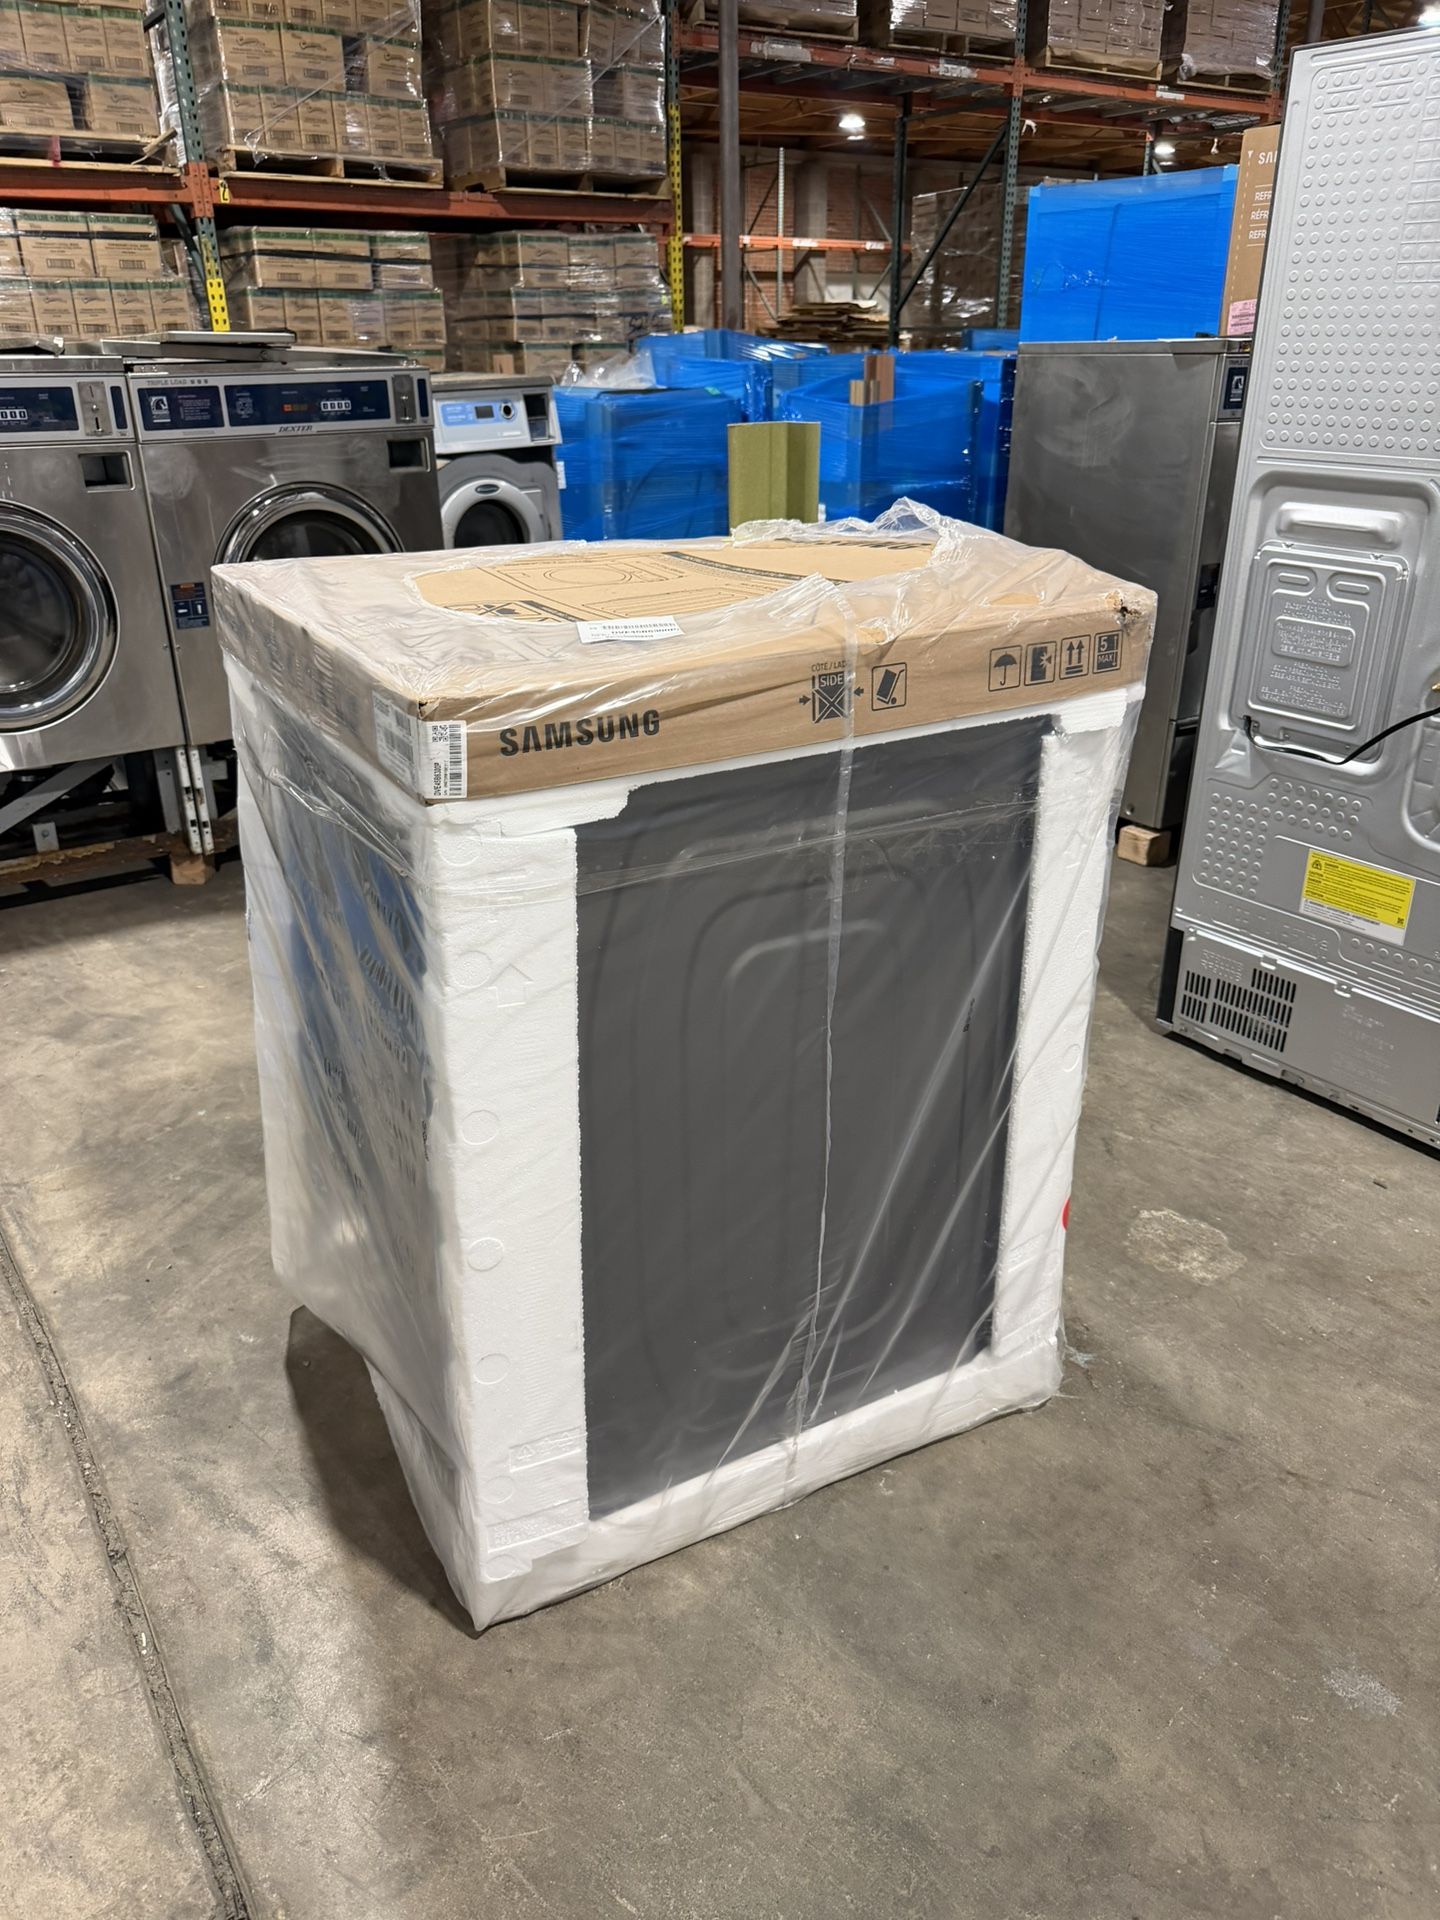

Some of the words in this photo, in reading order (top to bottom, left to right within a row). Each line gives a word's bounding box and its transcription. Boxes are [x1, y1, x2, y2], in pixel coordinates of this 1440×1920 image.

[279, 424, 313, 433] DEXTER
[1100, 636, 1108, 652] 5
[1098, 653, 1114, 663] MAX
[820, 673, 844, 687] SIDE
[500, 709, 660, 757] SAMSUNG
